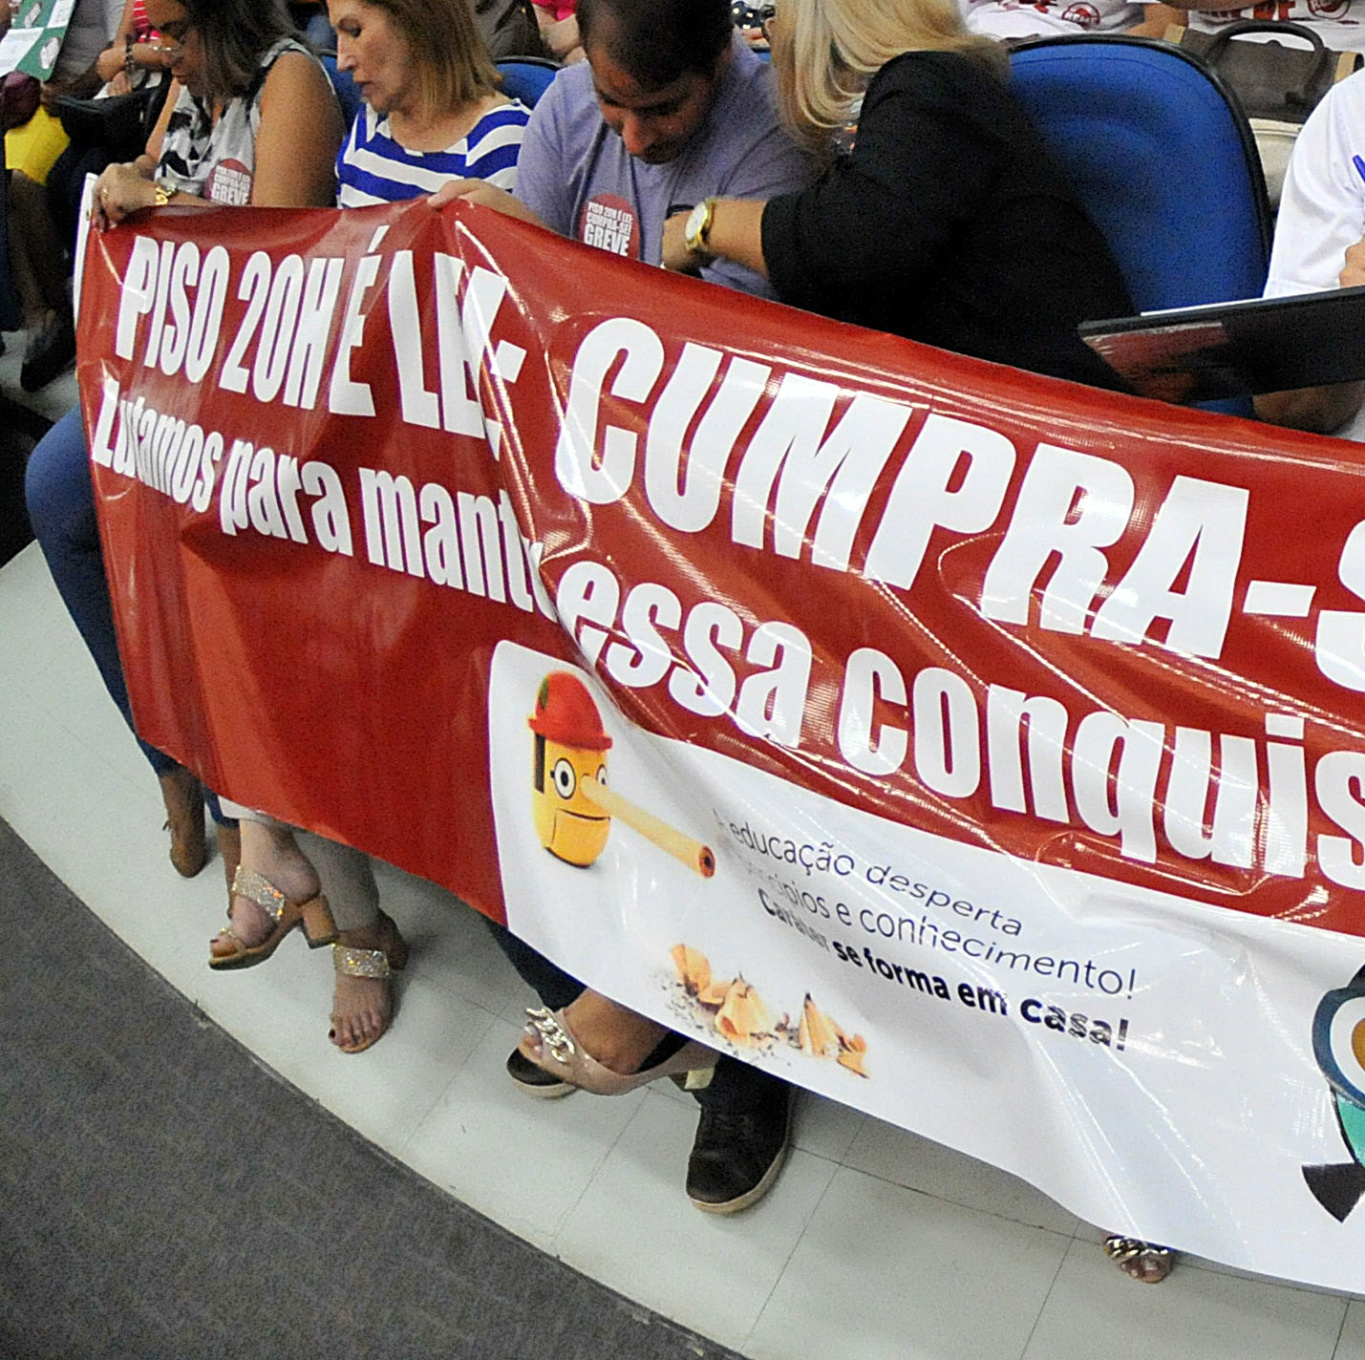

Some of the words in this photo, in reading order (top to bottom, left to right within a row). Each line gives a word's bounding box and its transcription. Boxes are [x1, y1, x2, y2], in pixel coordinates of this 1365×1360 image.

[211, 182, 249, 206] GREVE
[584, 223, 630, 257] GREVE
[115, 235, 230, 383] PISO
[218, 250, 344, 410] 20H
[329, 224, 390, 417] É
[91, 378, 225, 513] Lutamos
[219, 438, 354, 557] para
[557, 560, 813, 749] essa
[729, 820, 855, 877] educação
[866, 862, 1023, 937] desperta
[832, 940, 864, 968] se
[863, 947, 951, 1002] forma
[957, 982, 1009, 1018] em
[1020, 997, 1130, 1052] casa!
[836, 902, 852, 927] e
[859, 907, 1137, 1001] conhecimento!
